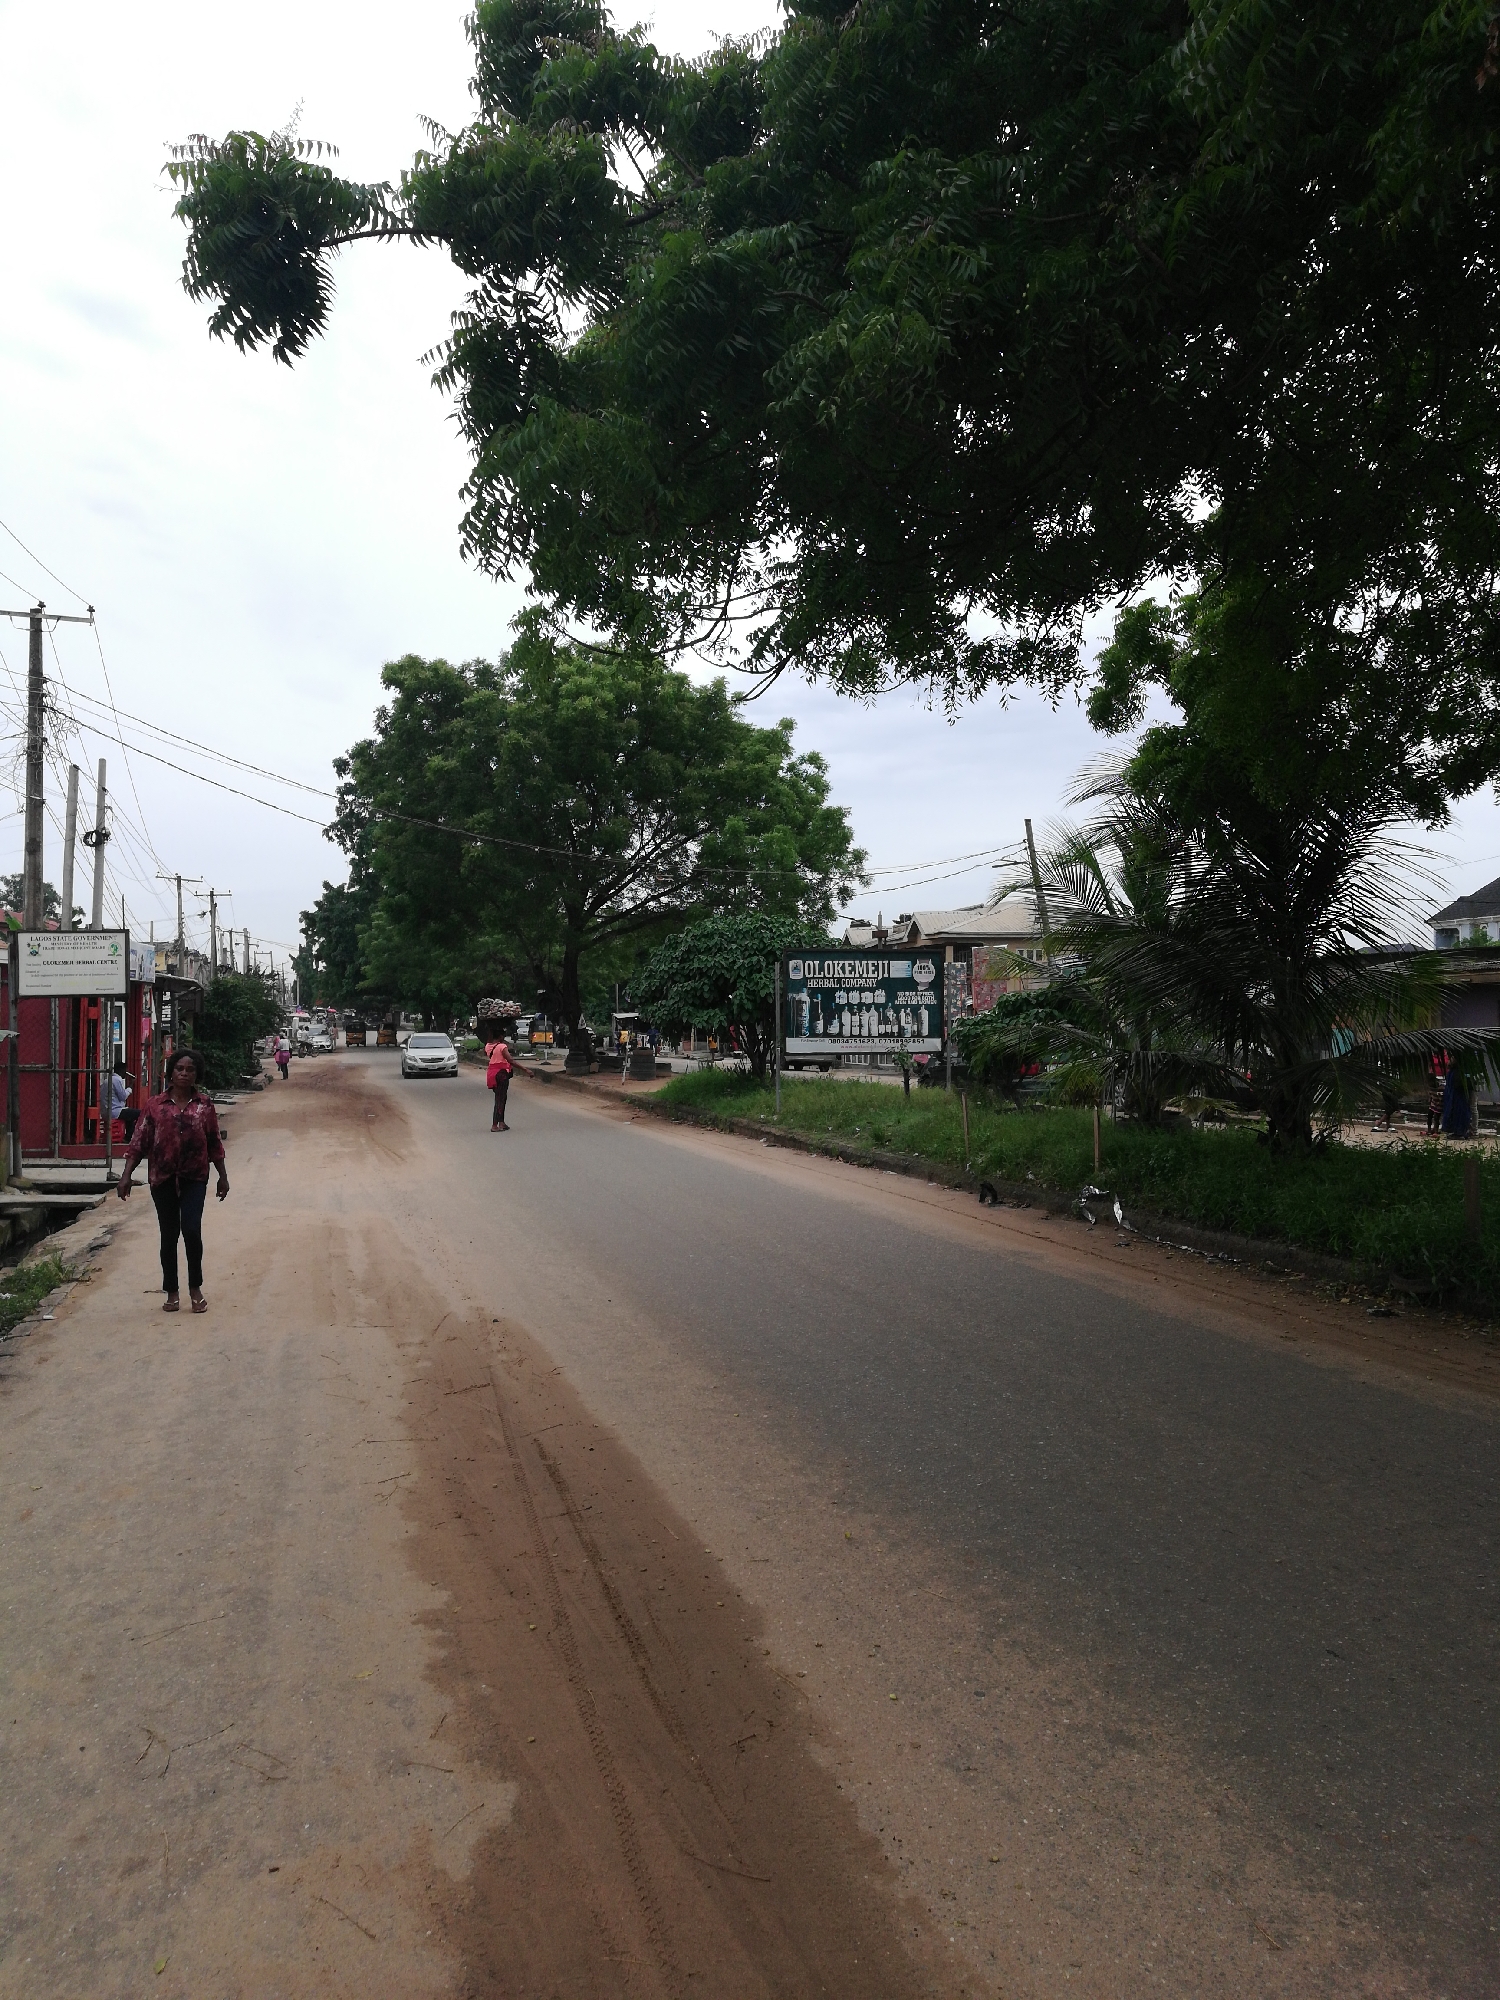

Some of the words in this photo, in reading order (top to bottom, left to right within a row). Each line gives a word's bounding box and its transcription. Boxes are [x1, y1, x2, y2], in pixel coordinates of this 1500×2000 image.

[804, 960, 889, 981] OLOKEMEJI
[807, 978, 840, 988] HERBAL
[841, 978, 878, 988] COMPANY
